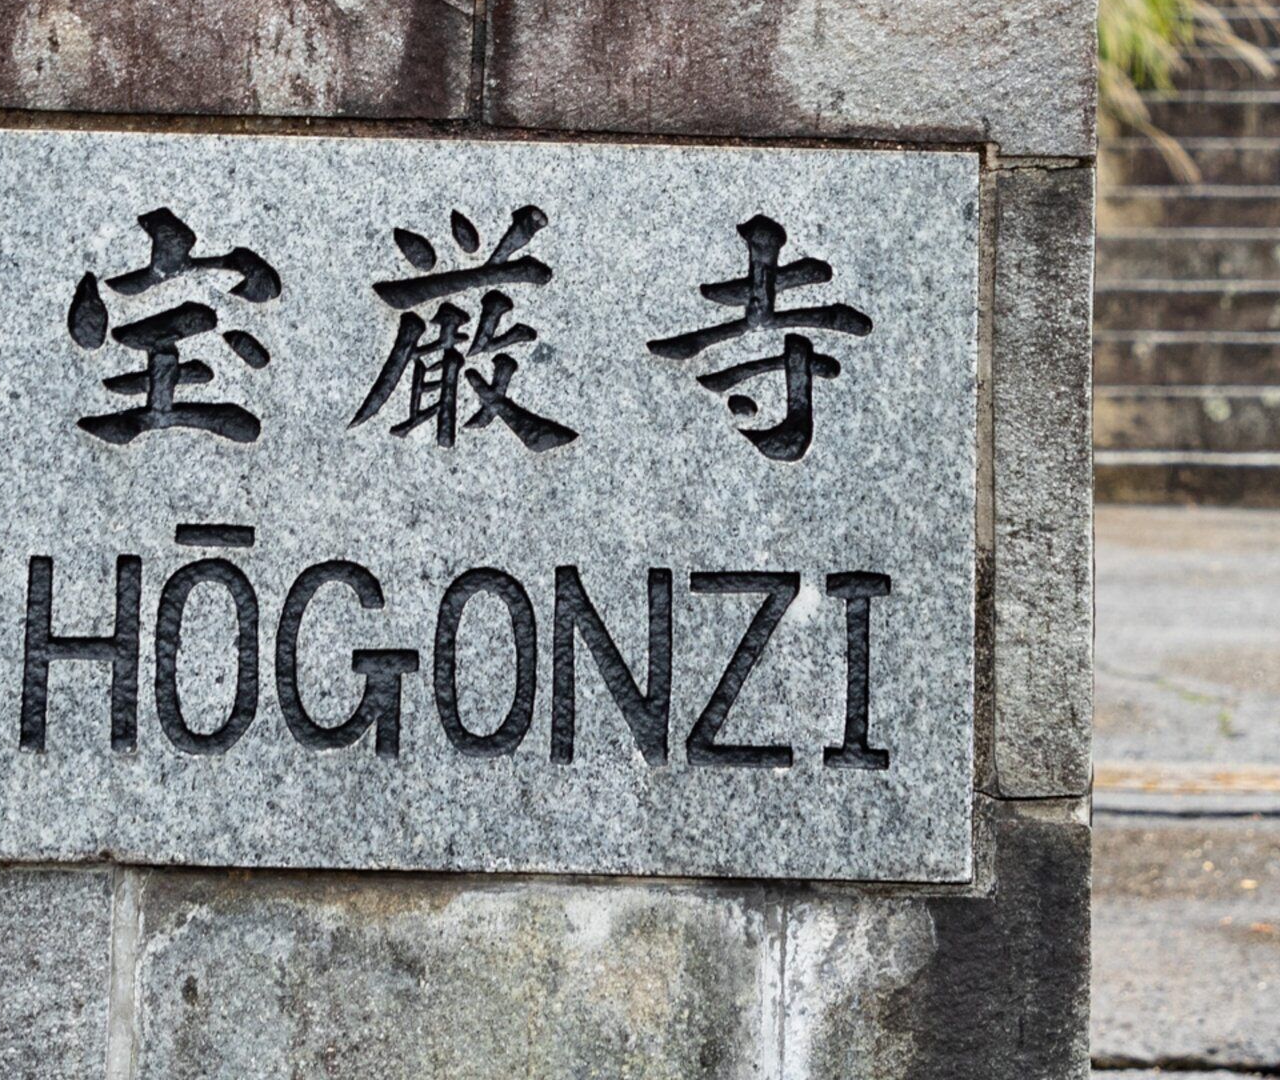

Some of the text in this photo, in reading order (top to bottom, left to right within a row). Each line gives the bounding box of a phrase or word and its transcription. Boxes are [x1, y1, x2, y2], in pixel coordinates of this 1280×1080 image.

[67, 205, 874, 462] 宝厳寺
[18, 523, 892, 770] HŌGONZI
